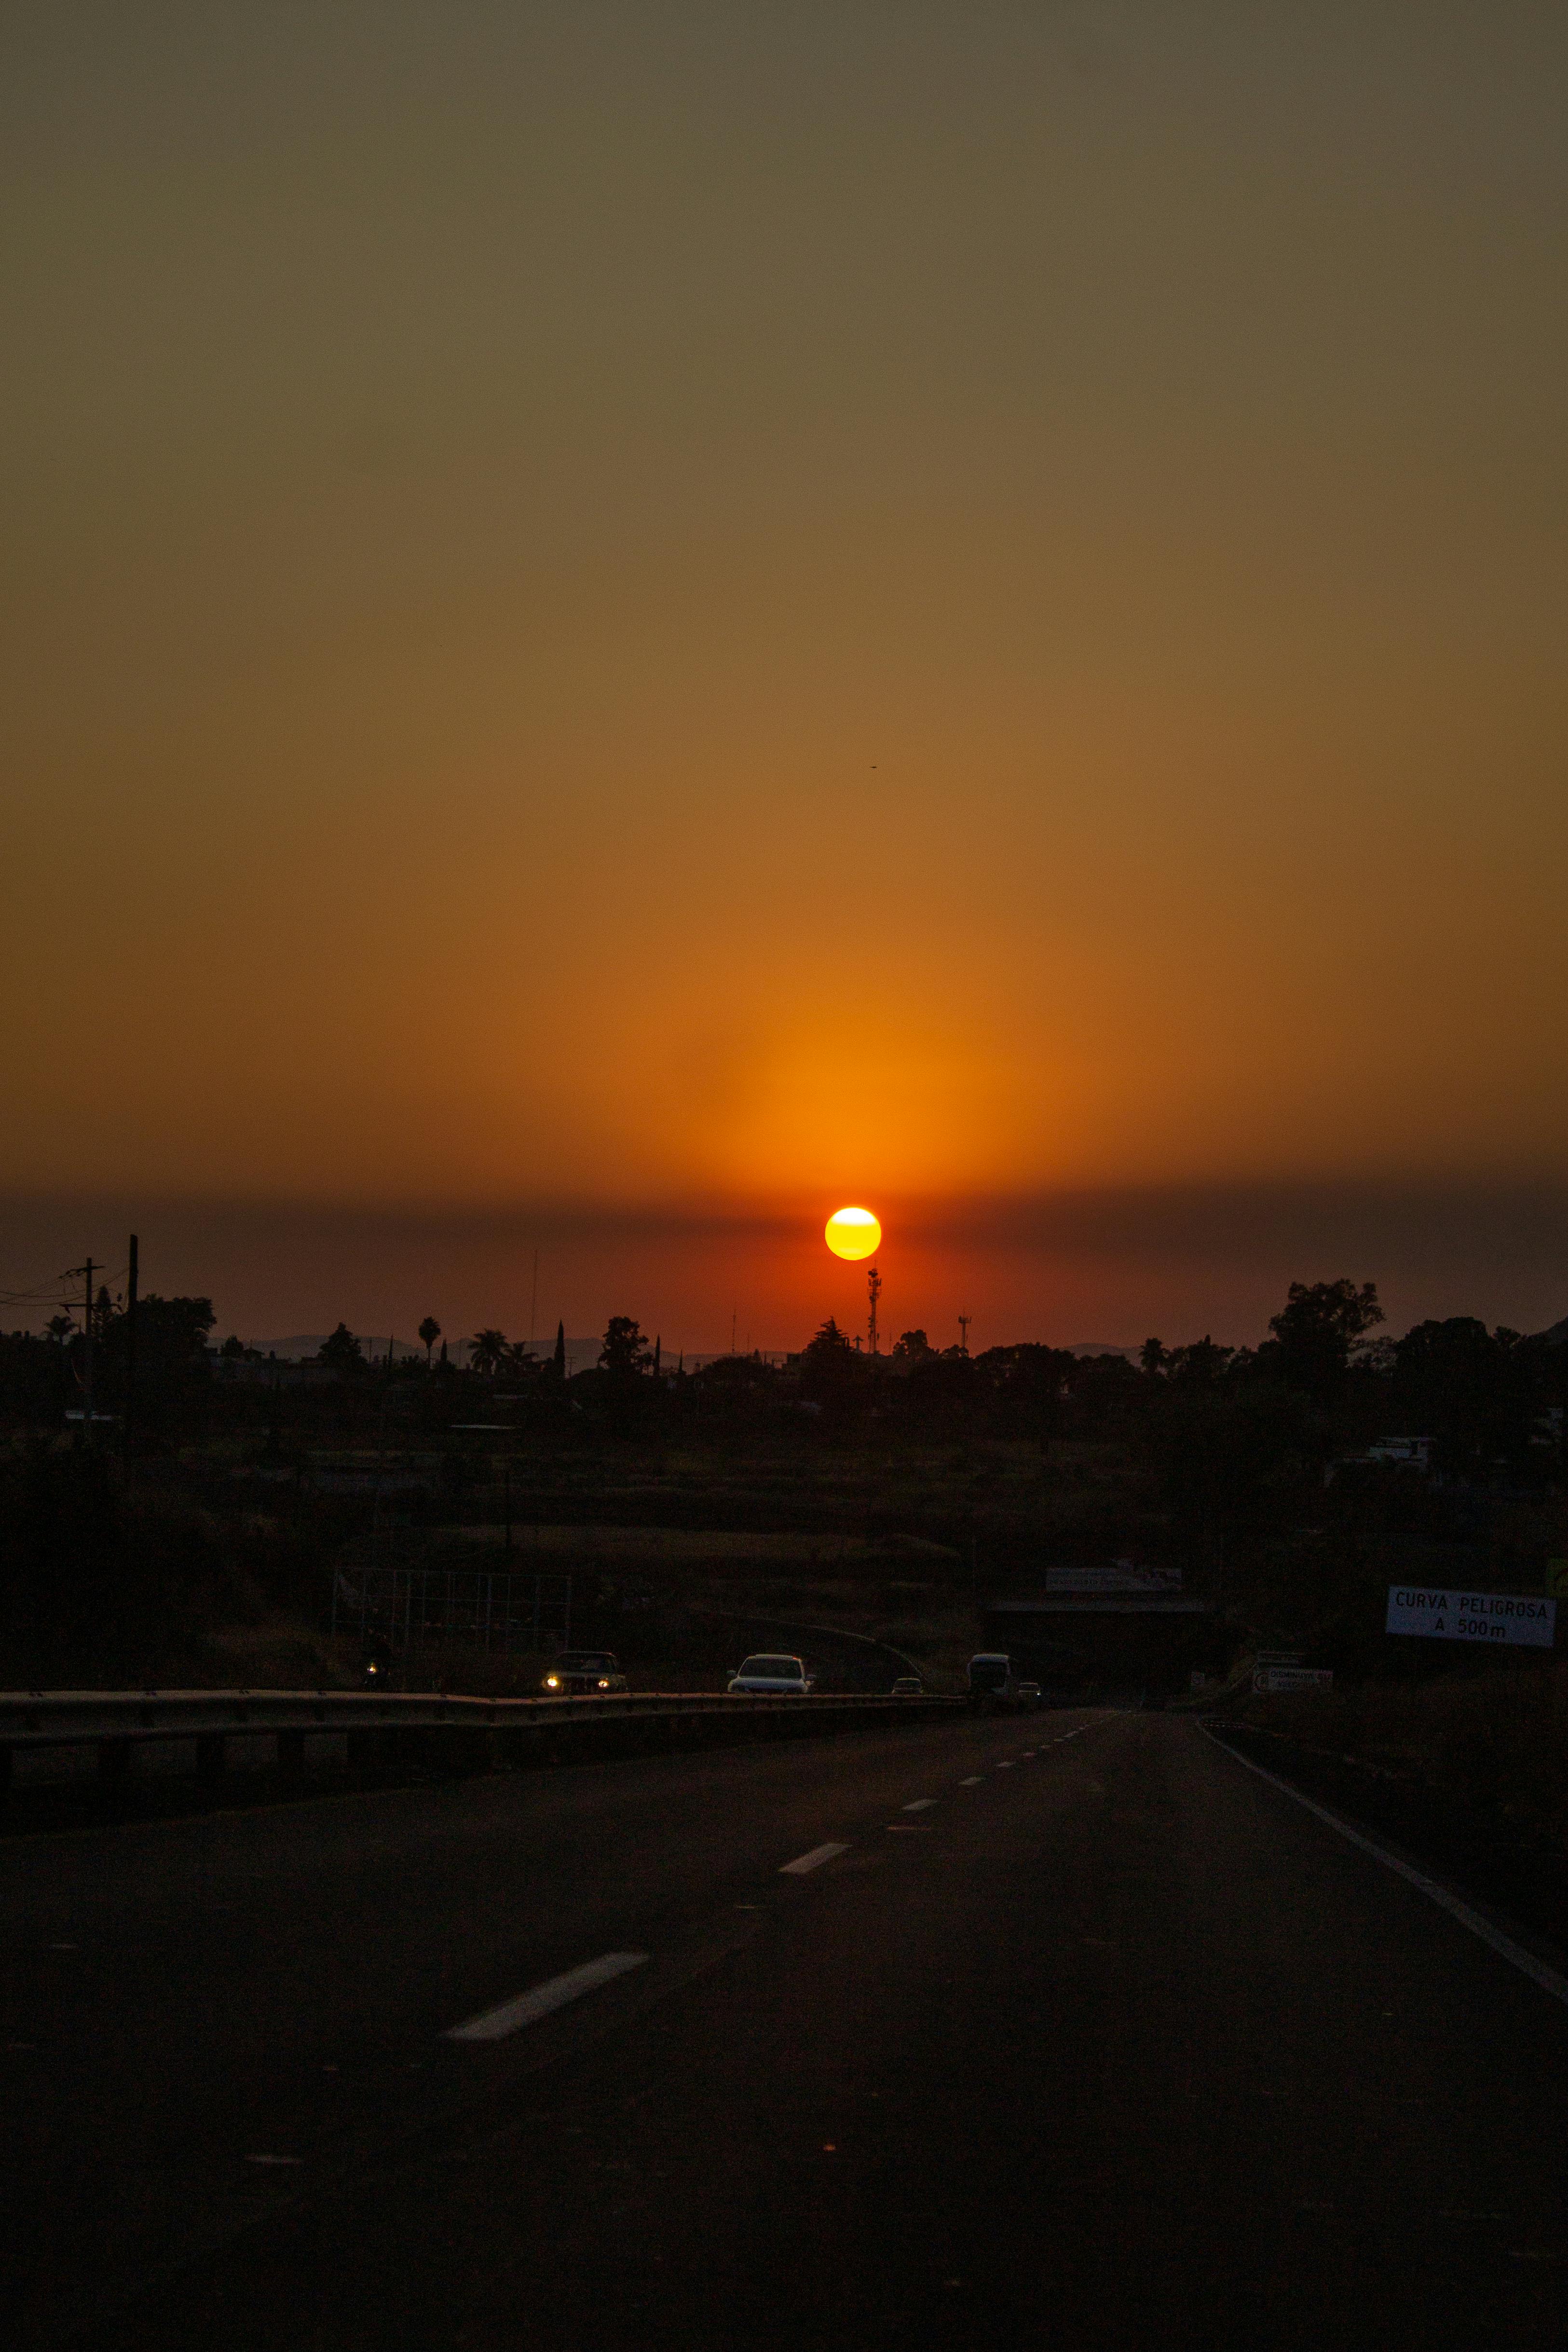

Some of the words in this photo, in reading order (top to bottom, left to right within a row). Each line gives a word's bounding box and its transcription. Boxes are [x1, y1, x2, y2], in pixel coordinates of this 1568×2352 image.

[1396, 1592, 1447, 1609] CURVA
[1460, 1597, 1547, 1618] PELIGROSA
[1435, 1617, 1445, 1631] A
[1458, 1619, 1505, 1638] 500m
